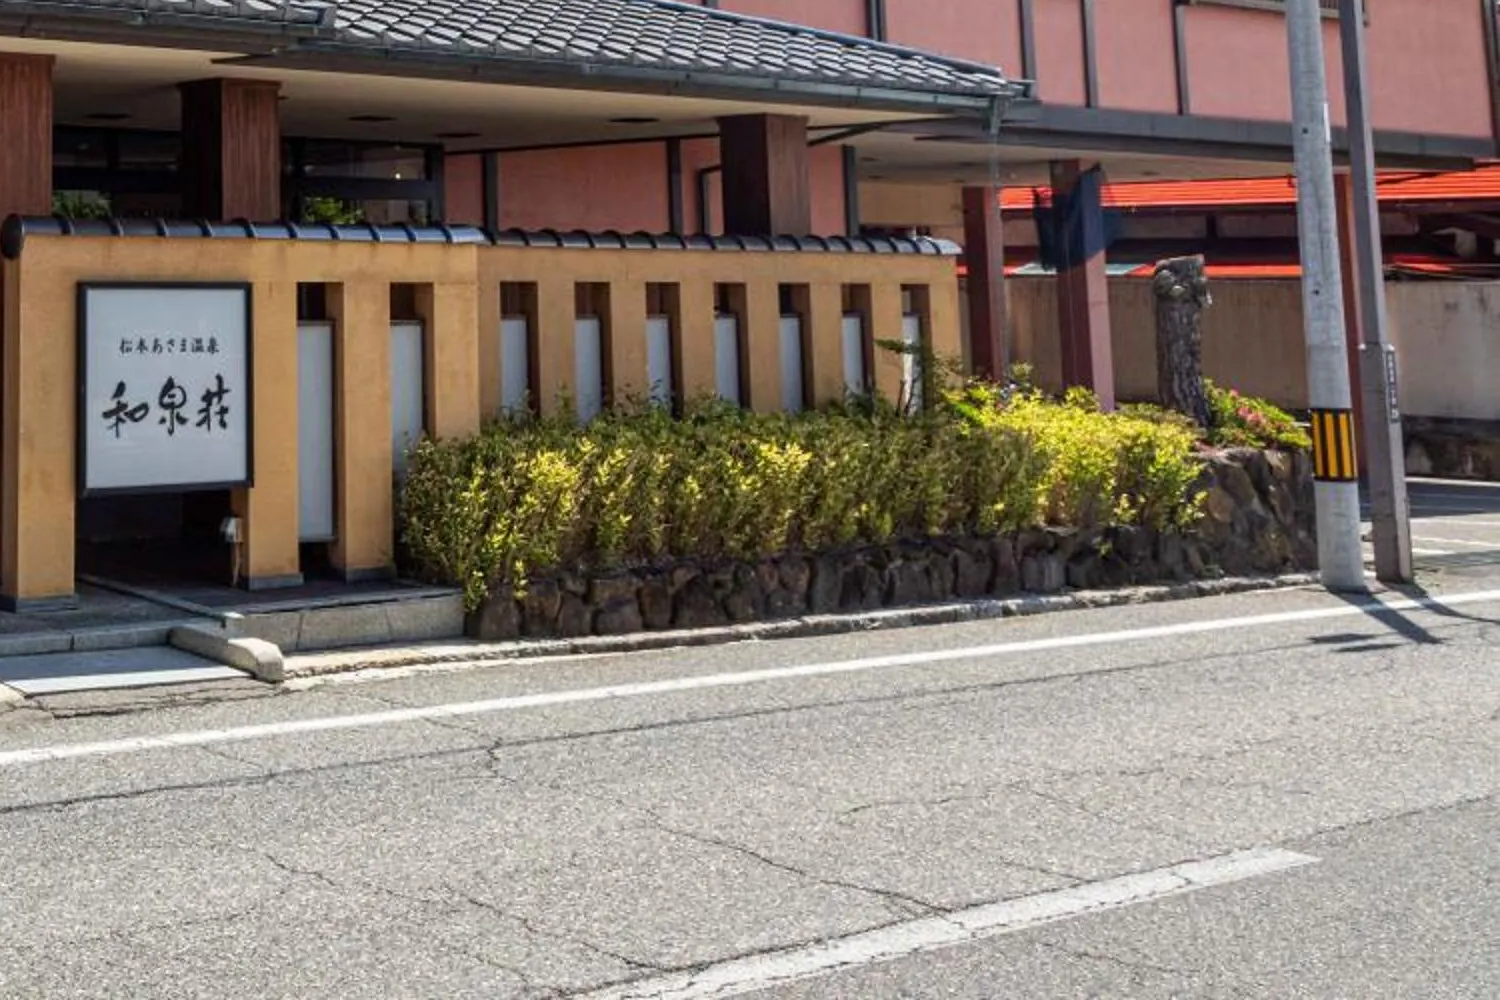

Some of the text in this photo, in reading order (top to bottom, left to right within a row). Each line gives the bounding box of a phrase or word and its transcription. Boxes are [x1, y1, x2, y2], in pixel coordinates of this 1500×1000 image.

[119, 337, 220, 355] 松本あさま温泉
[102, 374, 231, 439] 和泉荘
